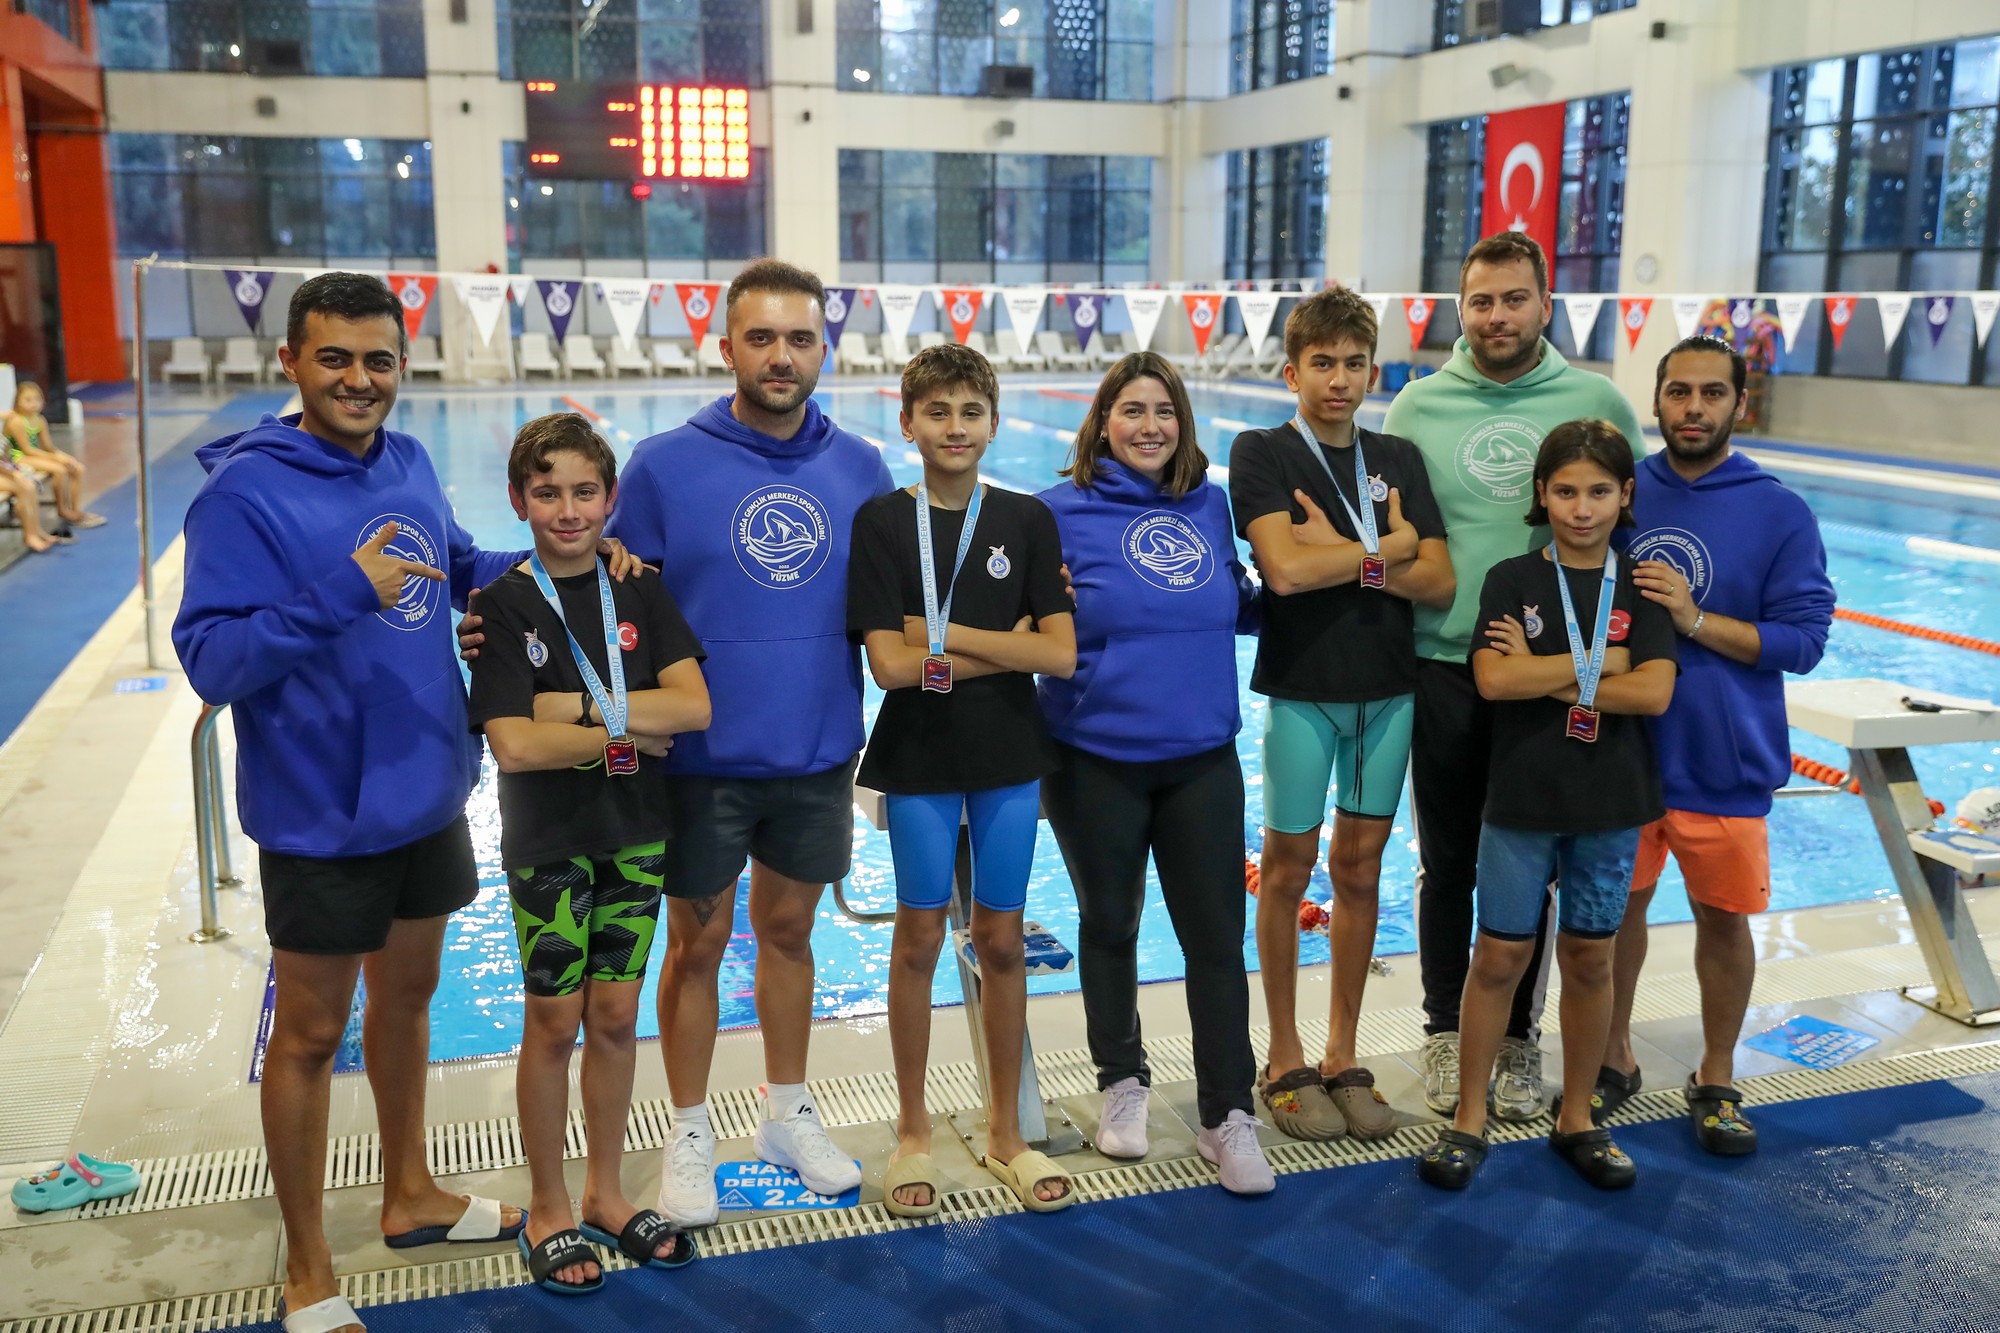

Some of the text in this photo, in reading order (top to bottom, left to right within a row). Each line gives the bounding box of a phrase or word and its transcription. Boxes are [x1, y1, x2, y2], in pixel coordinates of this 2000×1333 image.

[1492, 488, 1520, 498] YÜZME
[738, 518, 748, 544] ALİAĞA
[744, 496, 768, 518] GENÇLİK
[767, 492, 798, 502] MERKEZİ
[798, 498, 816, 514] SPOR
[1150, 516, 1178, 525] MERKEZİ
[1177, 521, 1192, 535] SPOR
[403, 524, 420, 537] SPOR
[1633, 536, 1659, 554] GENÇLİK
[1659, 534, 1689, 546] MERKEZİ
[1686, 543, 1701, 560] SPOR
[770, 571, 800, 582] YÜZME
[1168, 576, 1195, 586] YÜZME
[404, 605, 428, 622] YÜZME
[603, 594, 614, 634] TÜRKİYE
[580, 660, 621, 735] FEDERASYONU
[723, 1176, 800, 1187] DERİN
[544, 1234, 589, 1256] FILA
